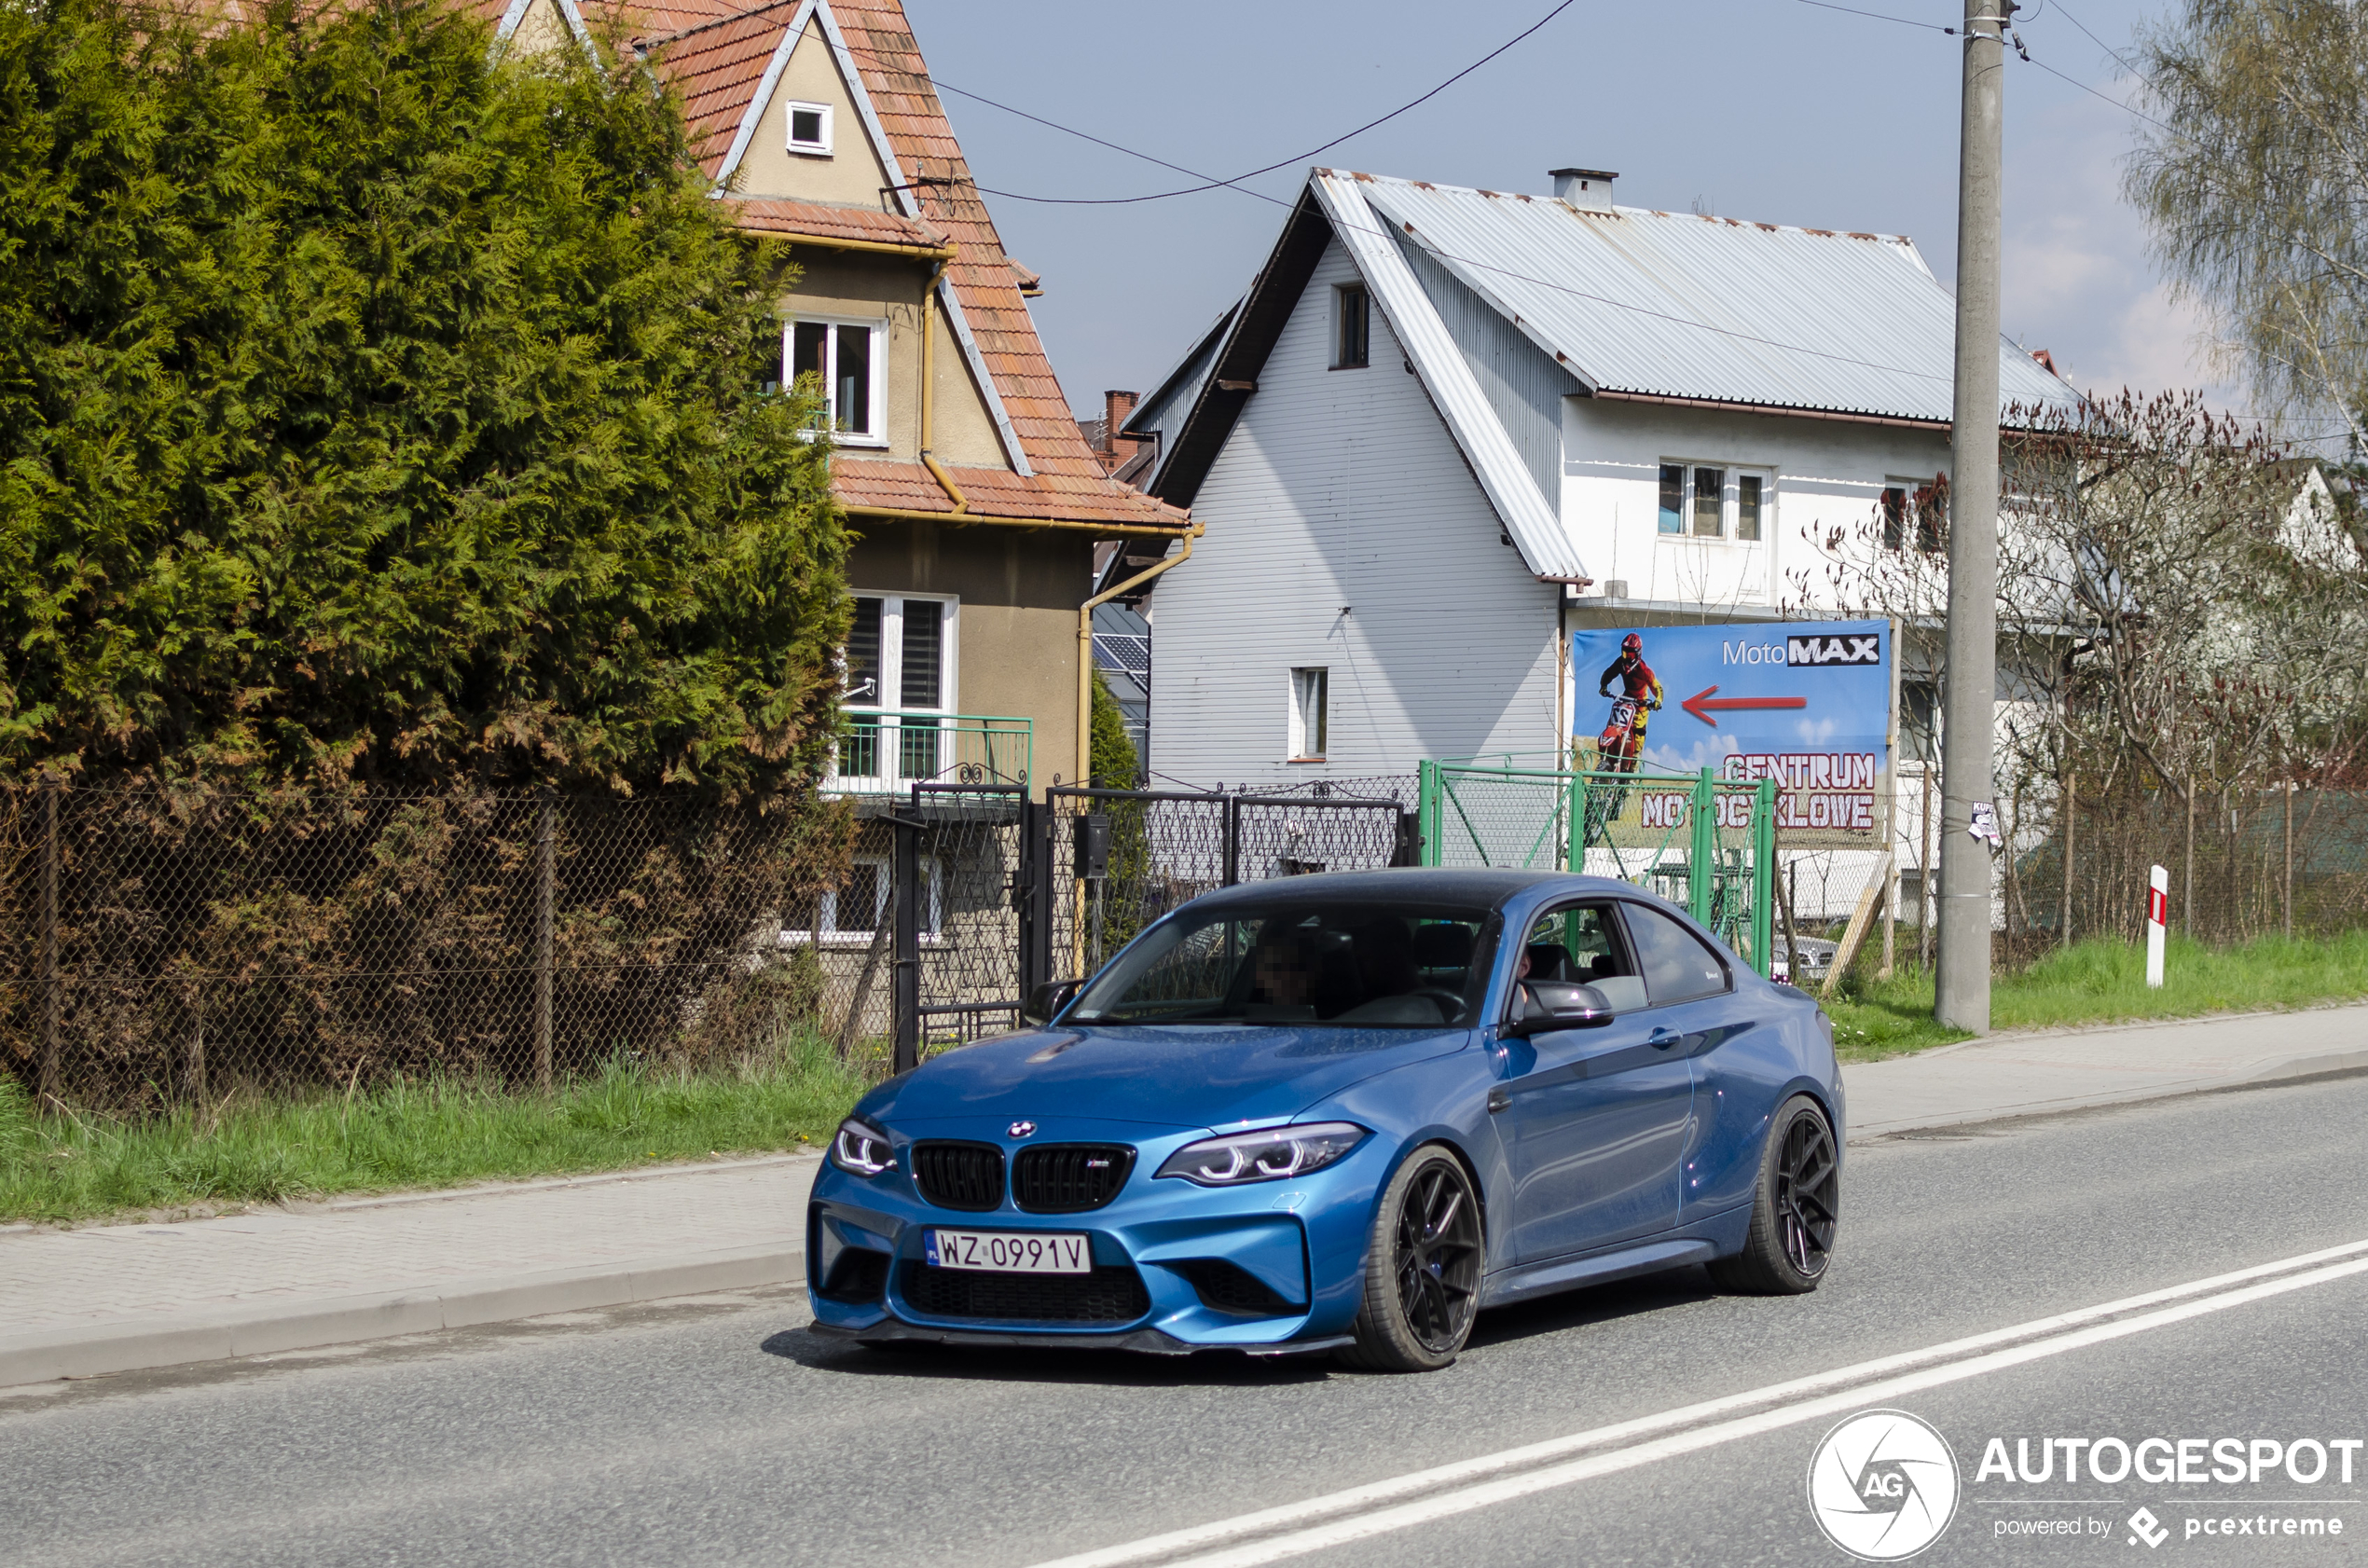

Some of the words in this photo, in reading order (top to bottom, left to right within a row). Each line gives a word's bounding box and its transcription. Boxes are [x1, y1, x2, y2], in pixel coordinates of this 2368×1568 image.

[1724, 753, 1875, 790] CENTRUM
[1642, 792, 1874, 830] MOOCKLOWE
[929, 1249, 939, 1259] PL
[941, 1234, 982, 1265] WZ
[991, 1238, 1081, 1268] 0991V
